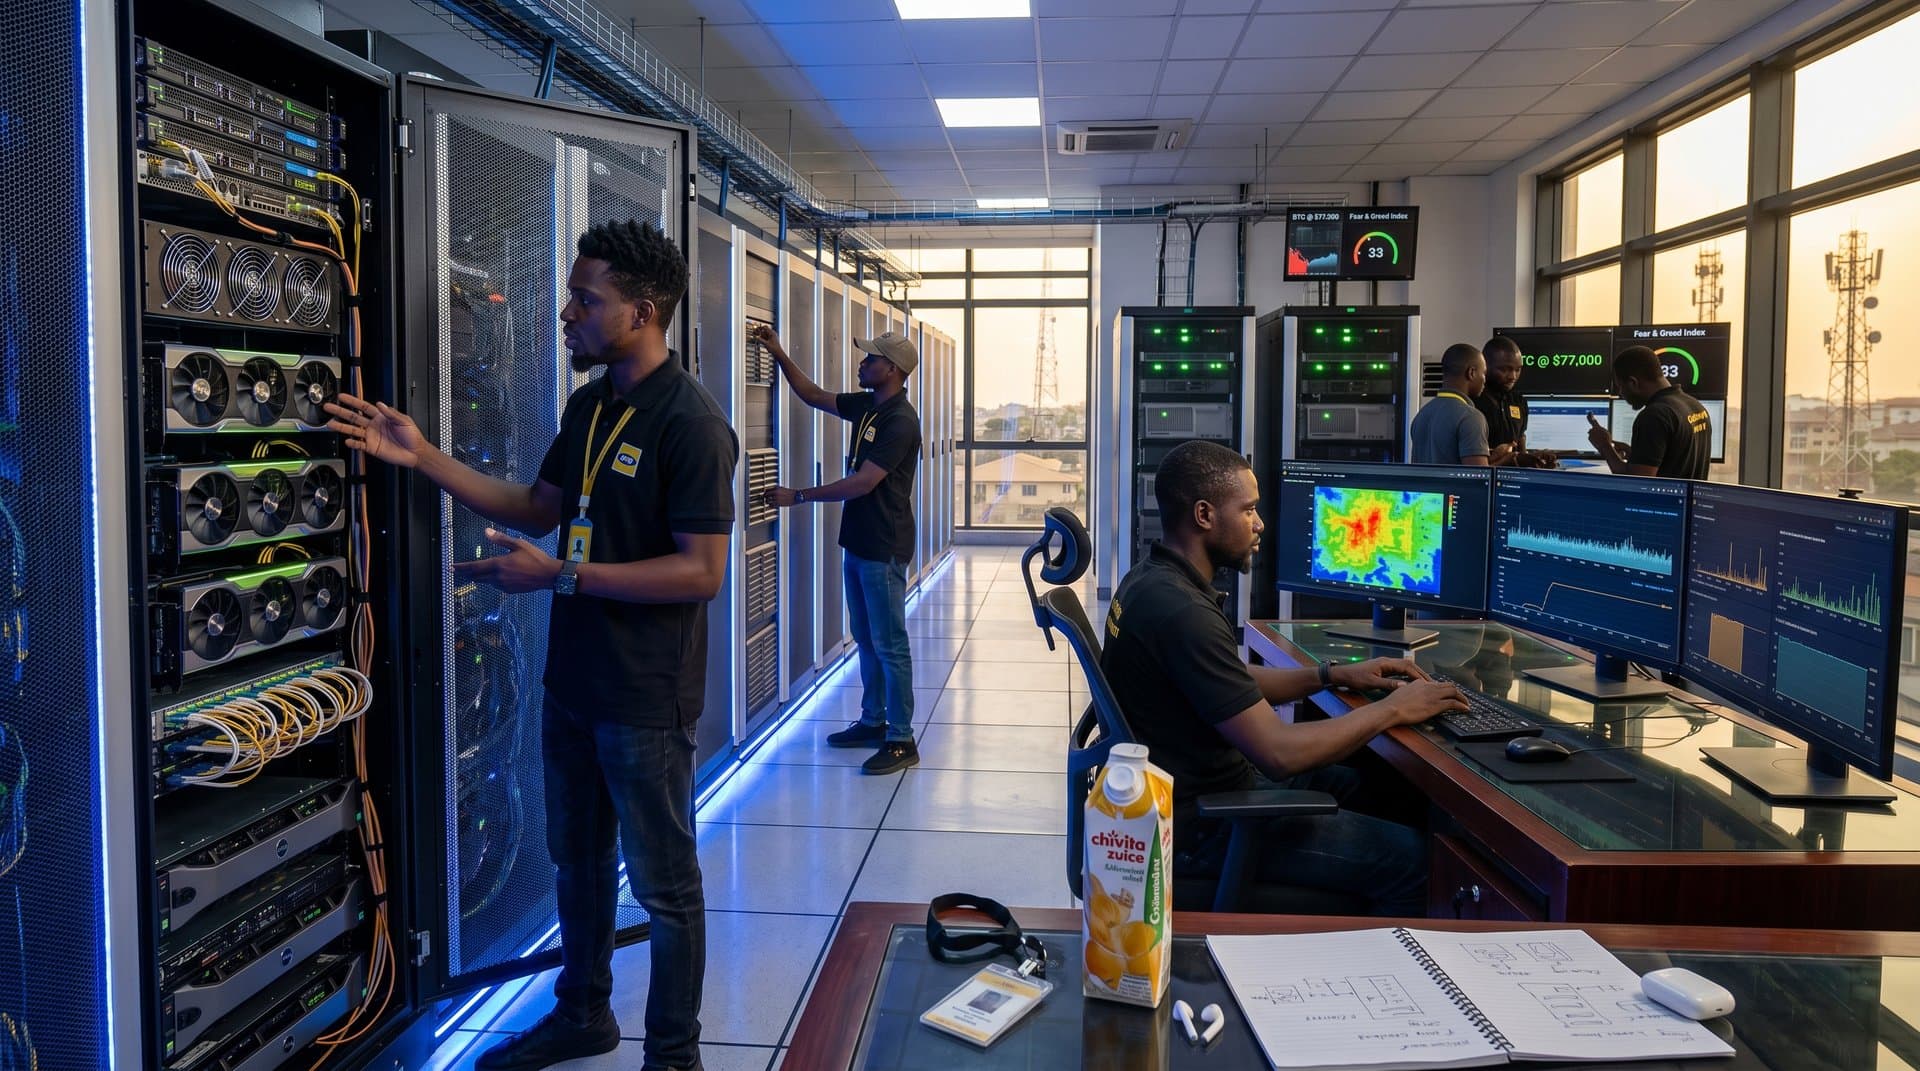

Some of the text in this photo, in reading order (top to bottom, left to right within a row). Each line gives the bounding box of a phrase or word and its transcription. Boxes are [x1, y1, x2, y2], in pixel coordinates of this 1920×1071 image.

[1292, 213, 1306, 221] BTC
[1306, 213, 1314, 222] @
[1370, 212, 1390, 220] Greed
[1390, 212, 1408, 220] Index
[1368, 247, 1384, 258] 33
[1634, 330, 1651, 338] Fear
[1659, 328, 1682, 337] Greed
[1683, 328, 1706, 336] Index
[1537, 355, 1550, 368] @
[1552, 353, 1602, 368] $77,000
[1661, 364, 1679, 377] 33
[1091, 830, 1145, 851] chivita
[1107, 850, 1145, 863] zuice
